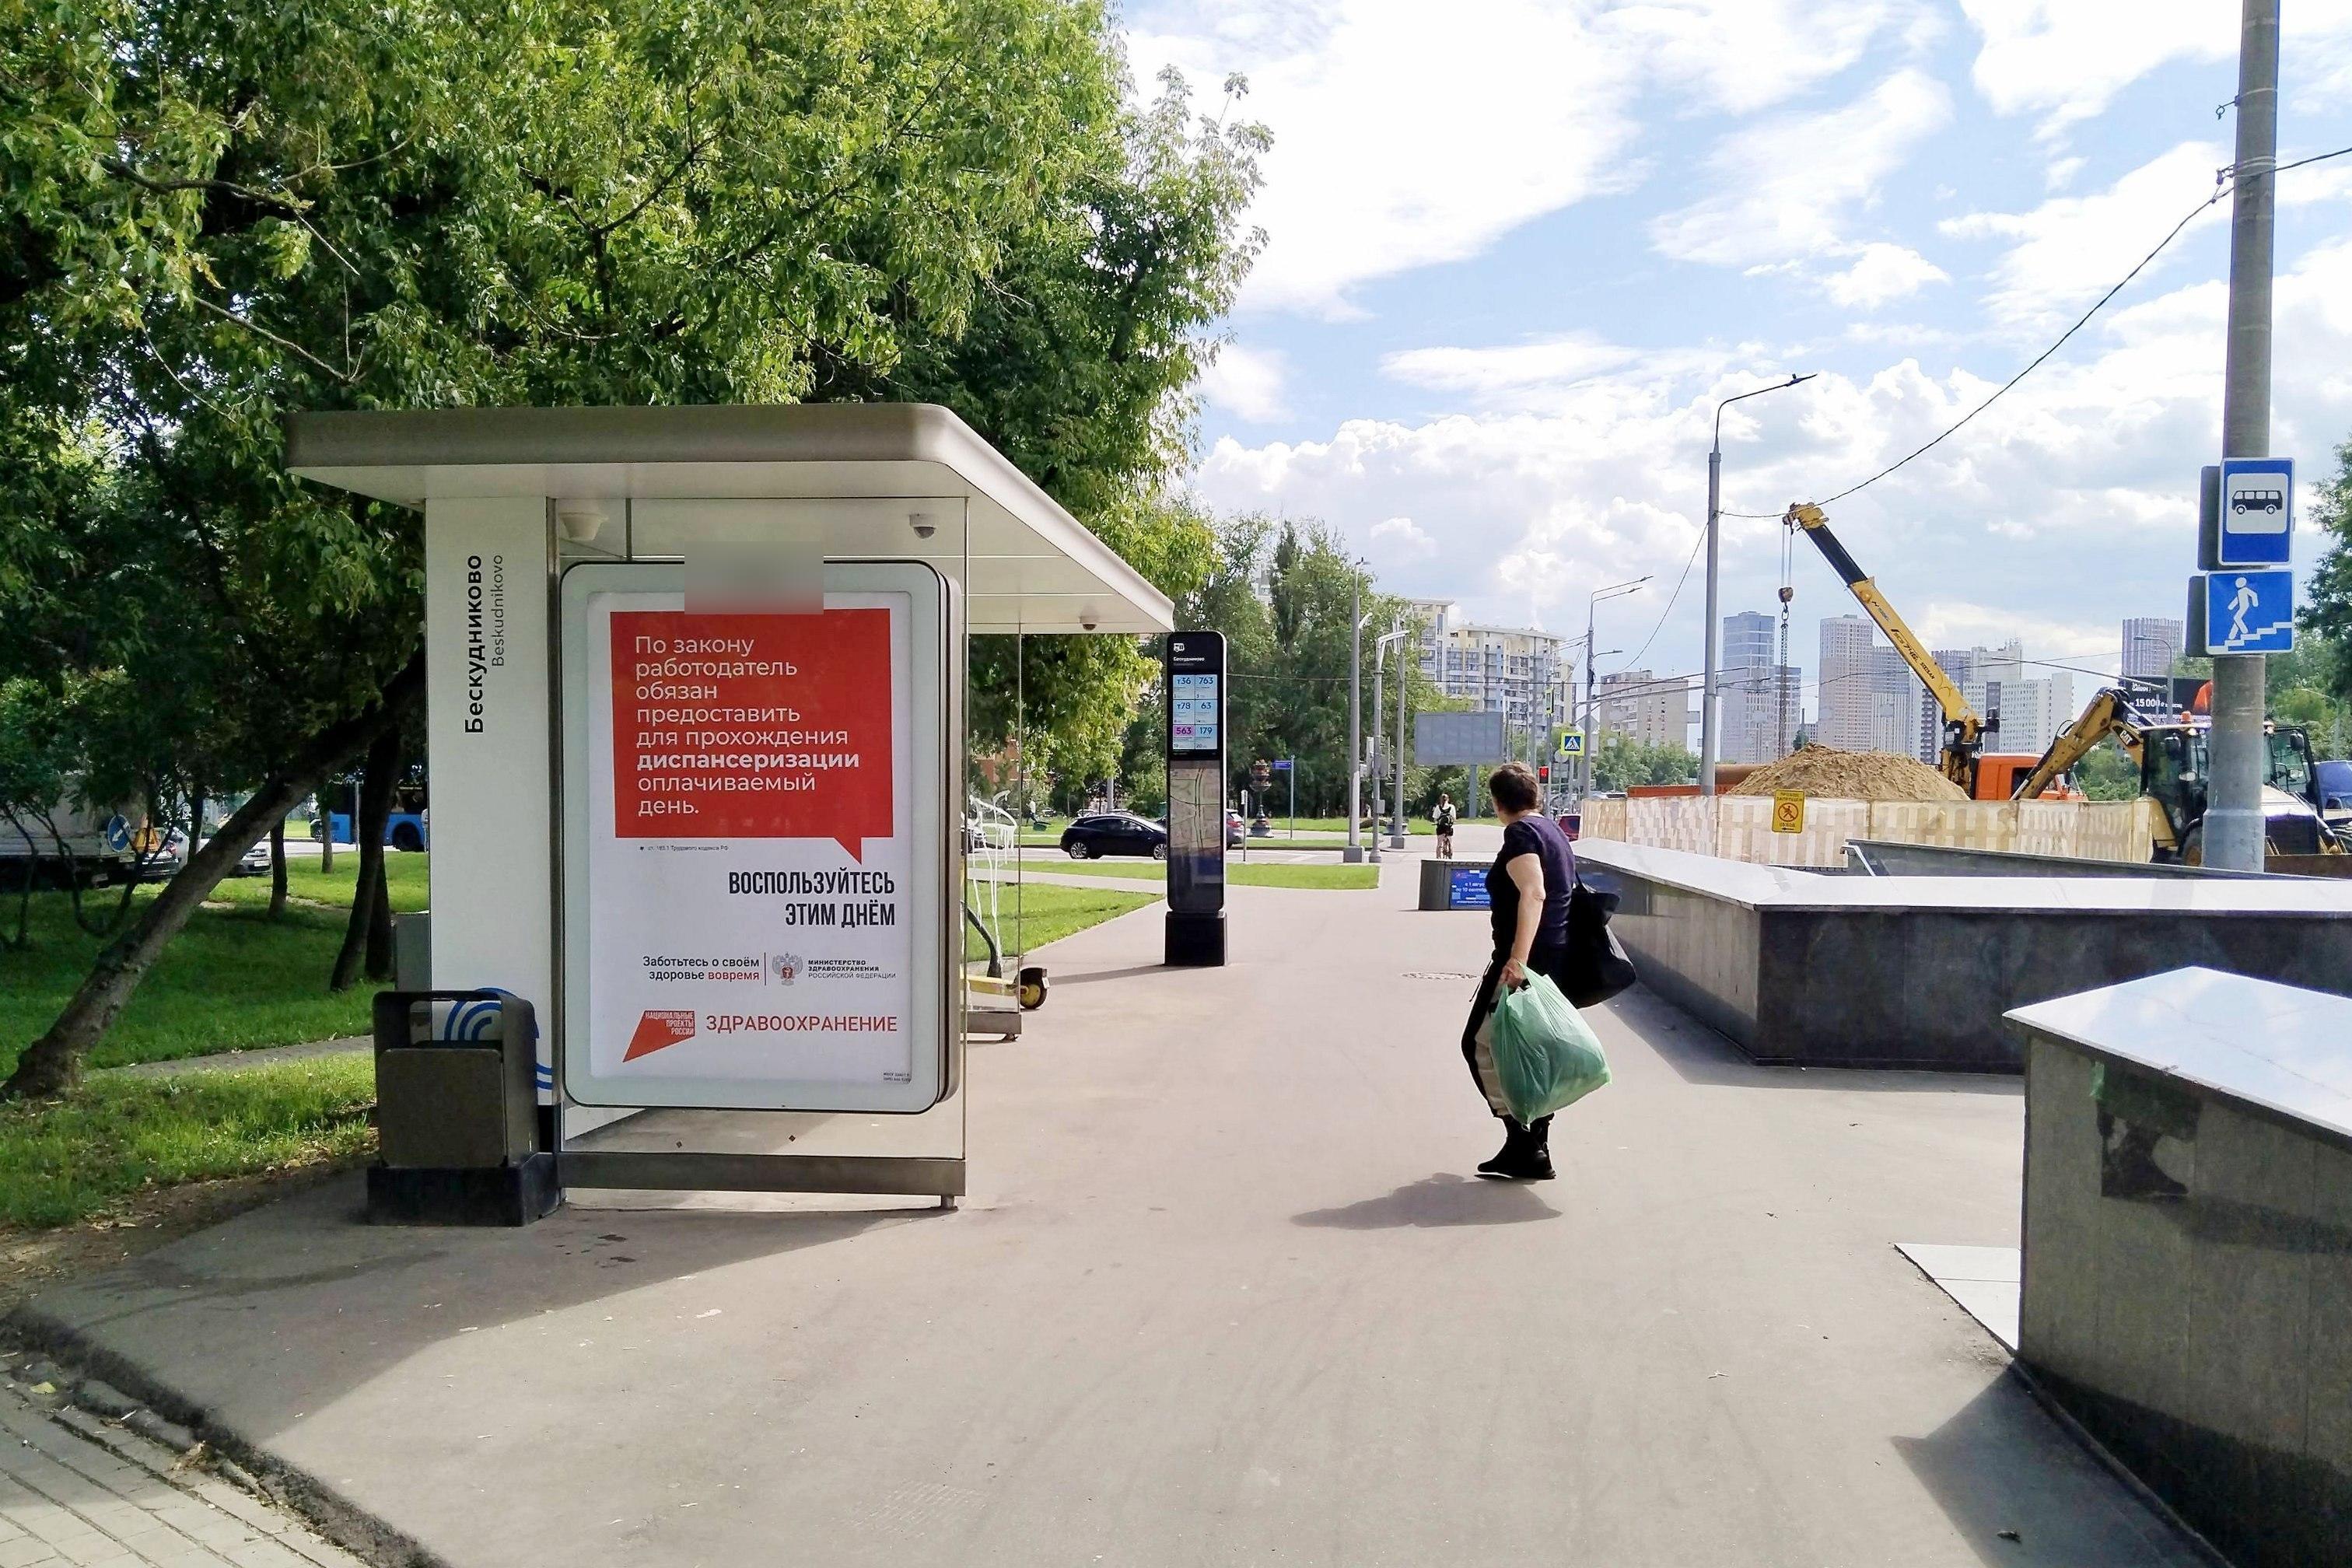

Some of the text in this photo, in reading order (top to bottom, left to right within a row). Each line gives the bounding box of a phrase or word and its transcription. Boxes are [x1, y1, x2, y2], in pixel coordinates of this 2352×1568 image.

[490, 555, 505, 667] Beskudnikovo
[464, 555, 487, 733] Бескудниково
[635, 635, 754, 657] По закону
[635, 657, 798, 681] работодатель
[635, 681, 718, 700] обязан
[637, 706, 800, 727] предоставить
[636, 729, 849, 749] для прохождения
[2119, 730, 2133, 745] CAT
[637, 752, 860, 772] диспансеризации
[638, 772, 816, 793] оплачиваемый
[638, 798, 699, 817] день.
[728, 867, 895, 895] ВОСПОЛЬЗУЙТЕСЬ
[785, 901, 895, 929] ЭТИМ ДНЁМ
[642, 955, 759, 967] Заботьтесь о своём
[649, 971, 760, 982] здоровье вовремя
[705, 1014, 898, 1034] ЗДРАВООХРАНЕНИЕ
